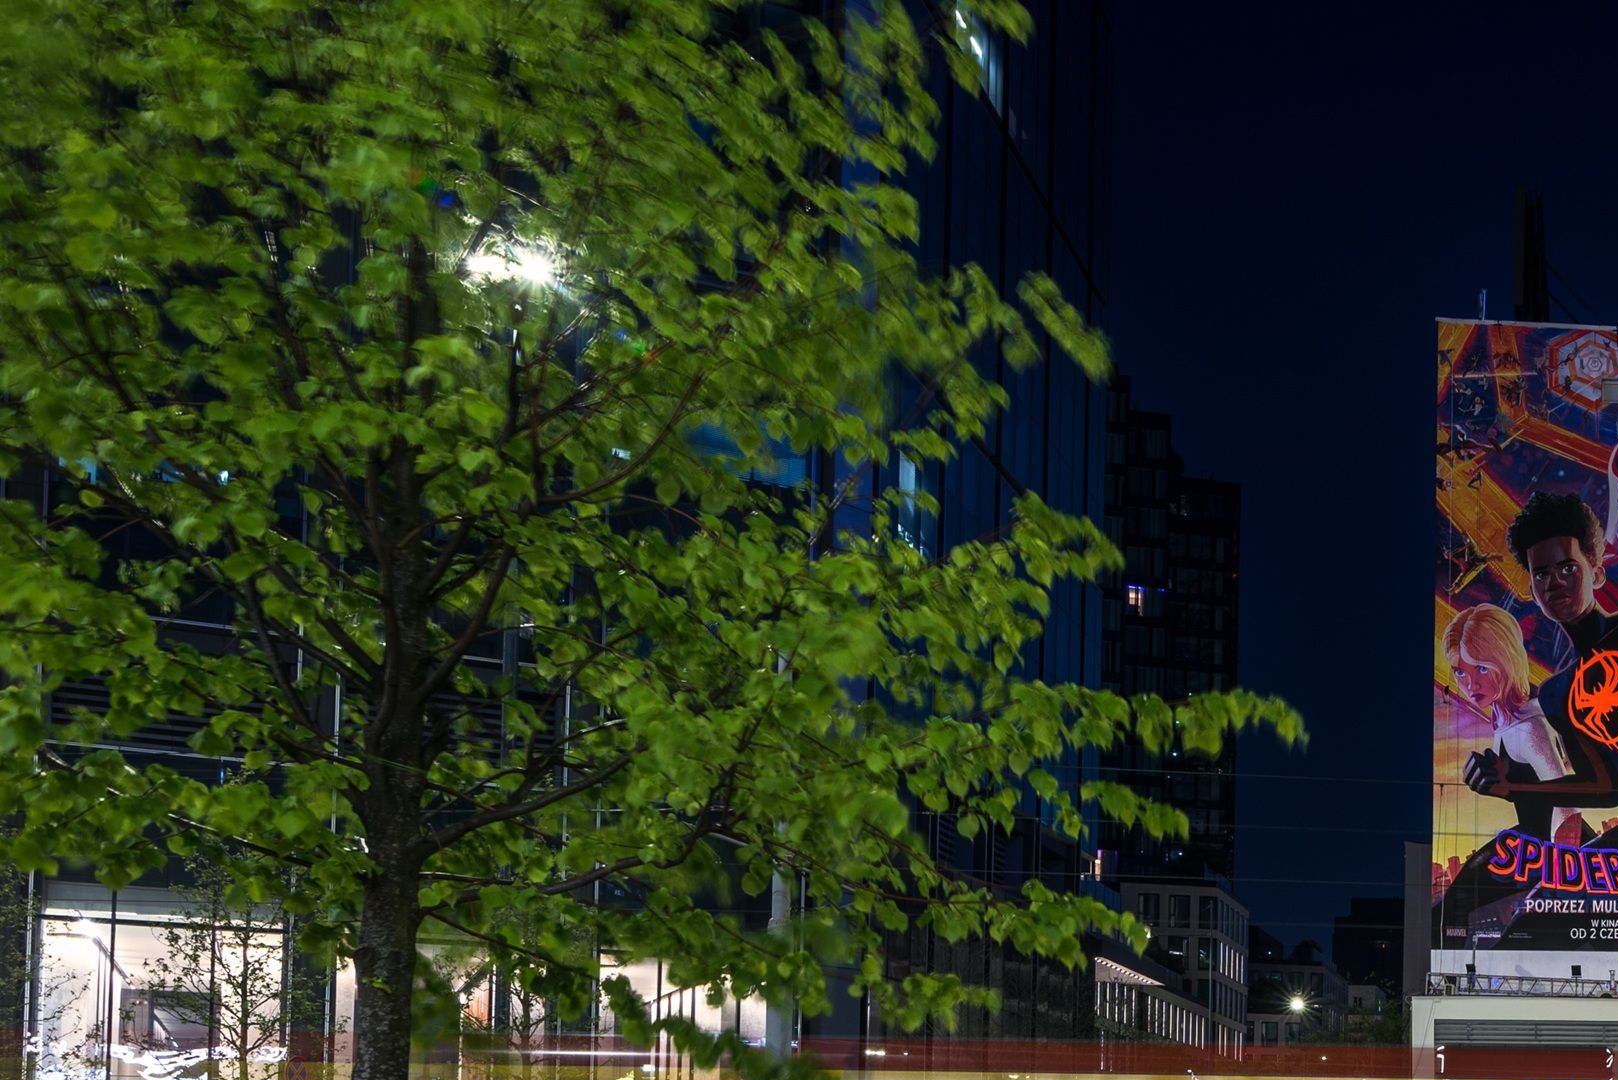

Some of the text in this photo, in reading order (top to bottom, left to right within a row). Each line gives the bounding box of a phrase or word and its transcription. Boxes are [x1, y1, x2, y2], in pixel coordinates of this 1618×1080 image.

[1525, 899, 1585, 914] POPRZEZ
[1591, 919, 1600, 928] W
[1446, 928, 1467, 937] MARVEL
[1570, 928, 1587, 939] OD
[1590, 928, 1597, 939] 2
